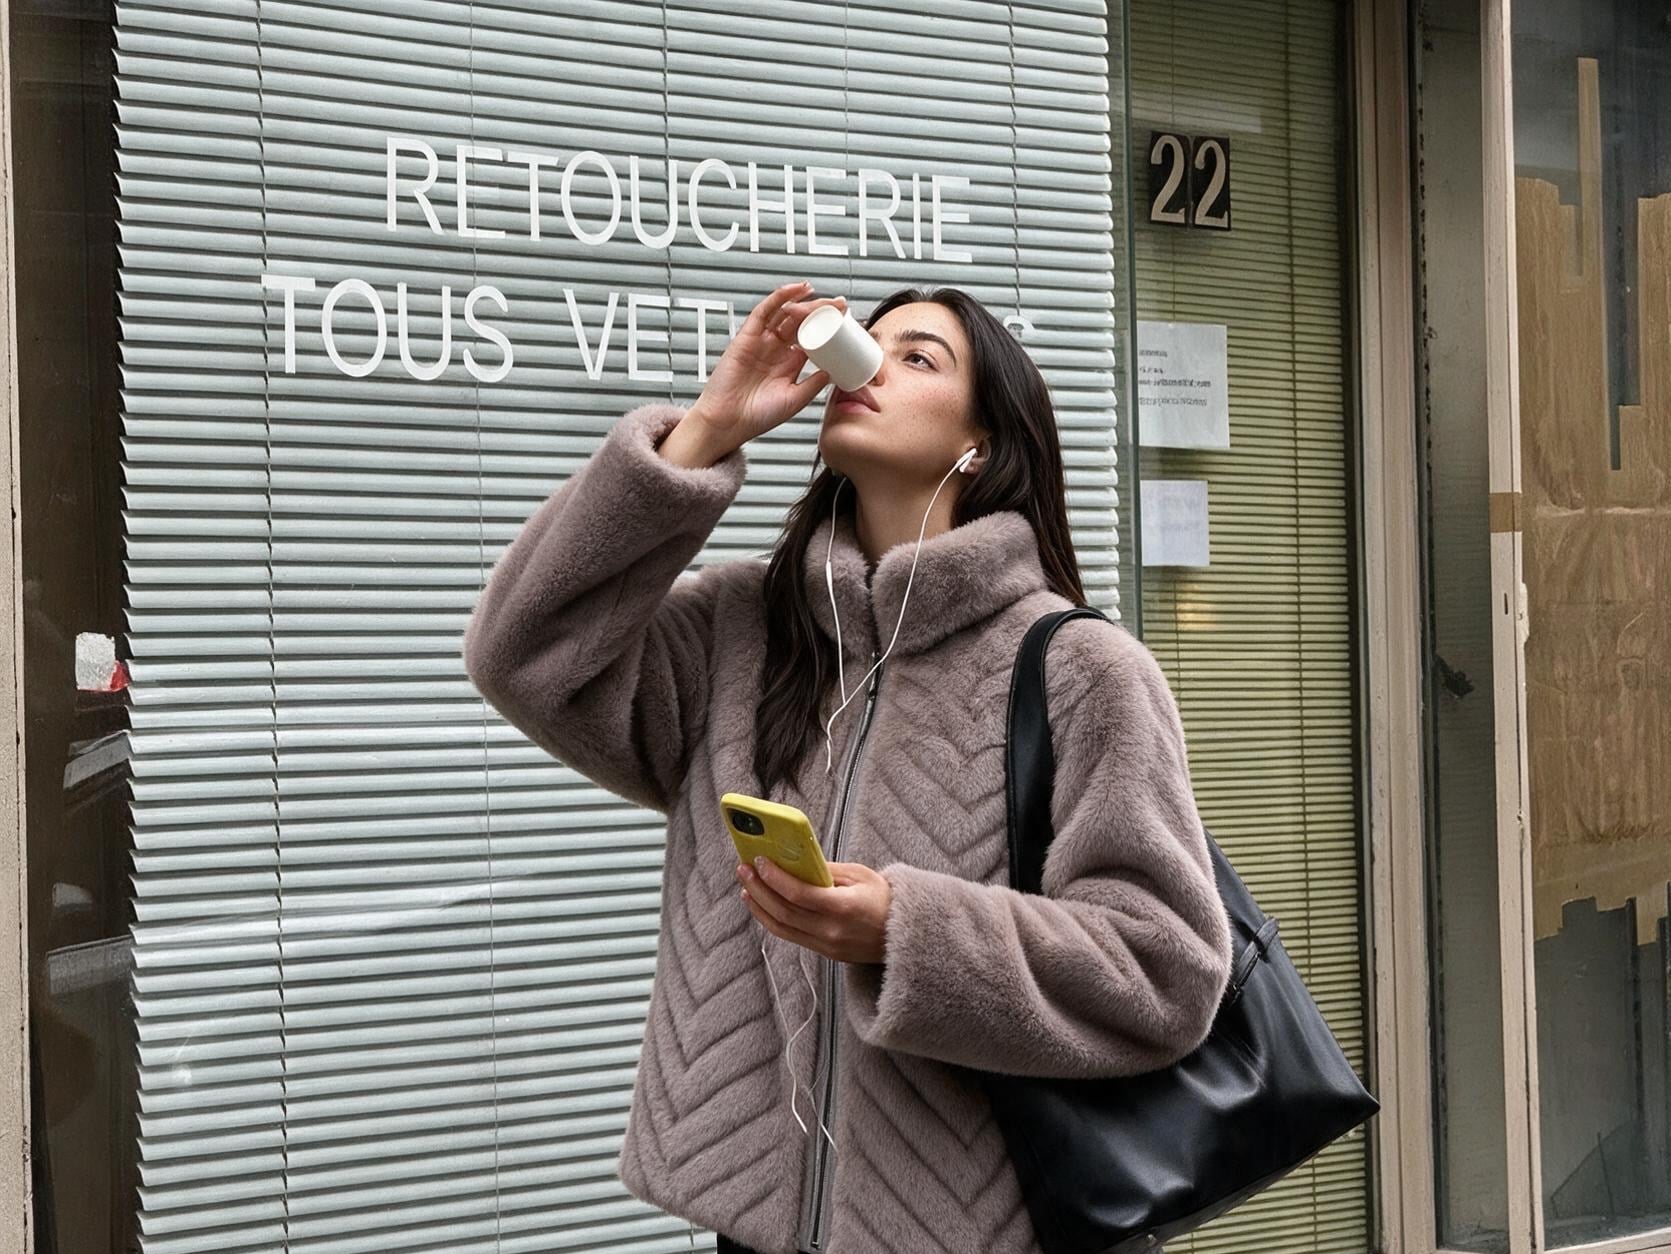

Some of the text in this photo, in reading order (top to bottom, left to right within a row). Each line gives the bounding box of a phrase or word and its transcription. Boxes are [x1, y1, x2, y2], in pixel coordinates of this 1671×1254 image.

[386, 136, 973, 264] RETOUCHERIE
[1150, 134, 1229, 229] 22
[261, 274, 736, 384] TOUS VET
